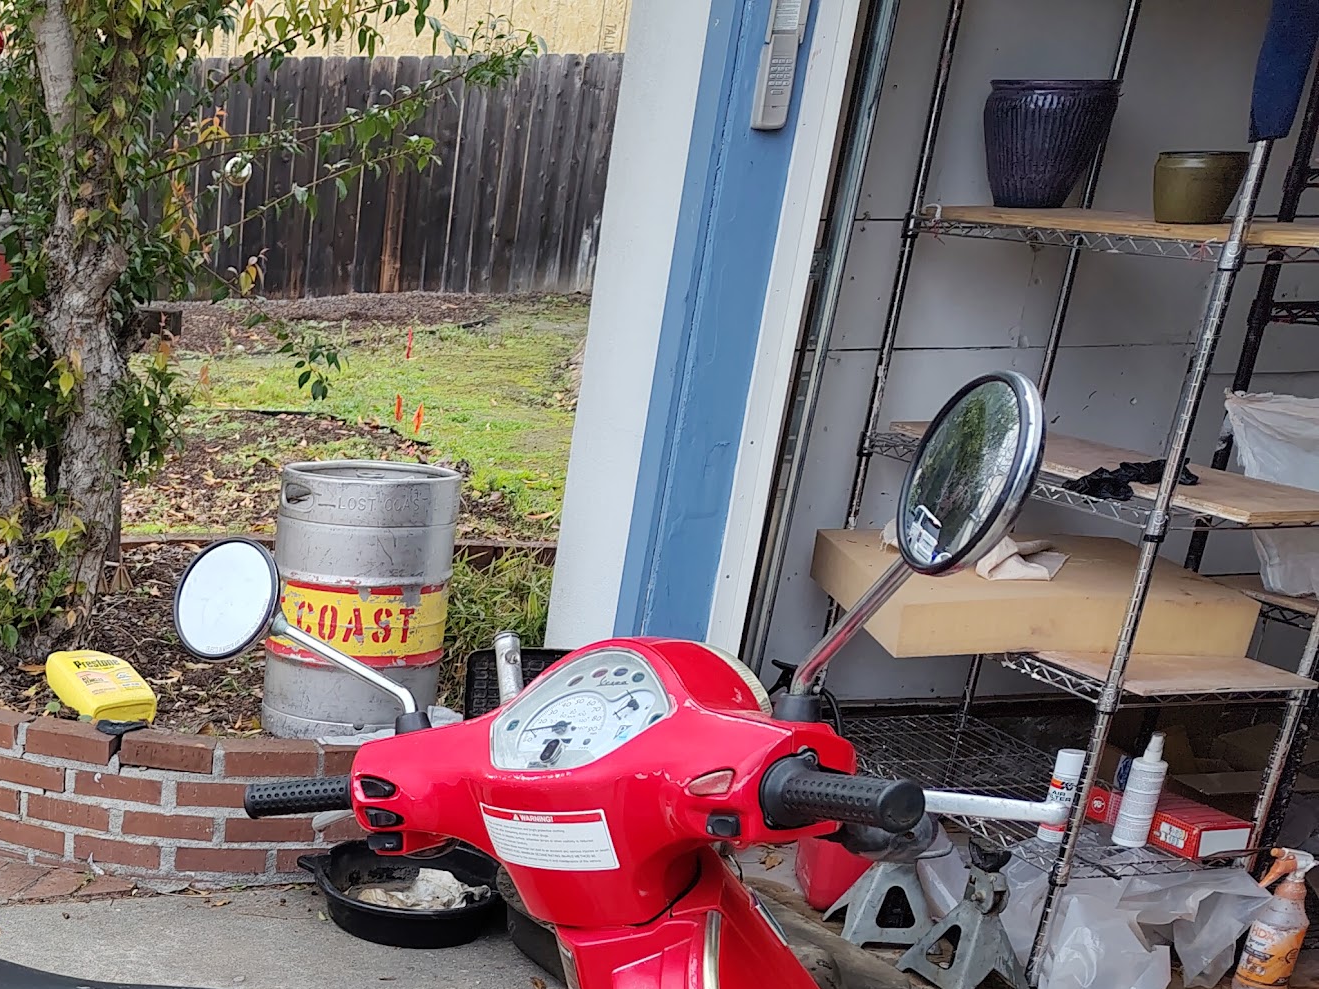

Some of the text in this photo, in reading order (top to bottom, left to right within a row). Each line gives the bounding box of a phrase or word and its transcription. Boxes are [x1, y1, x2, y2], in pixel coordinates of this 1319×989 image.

[338, 497, 376, 511] LOST
[297, 601, 415, 644] COAST
[73, 658, 121, 669] Prestone
[596, 676, 629, 687] Vespa
[519, 814, 554, 823] WARNING!
